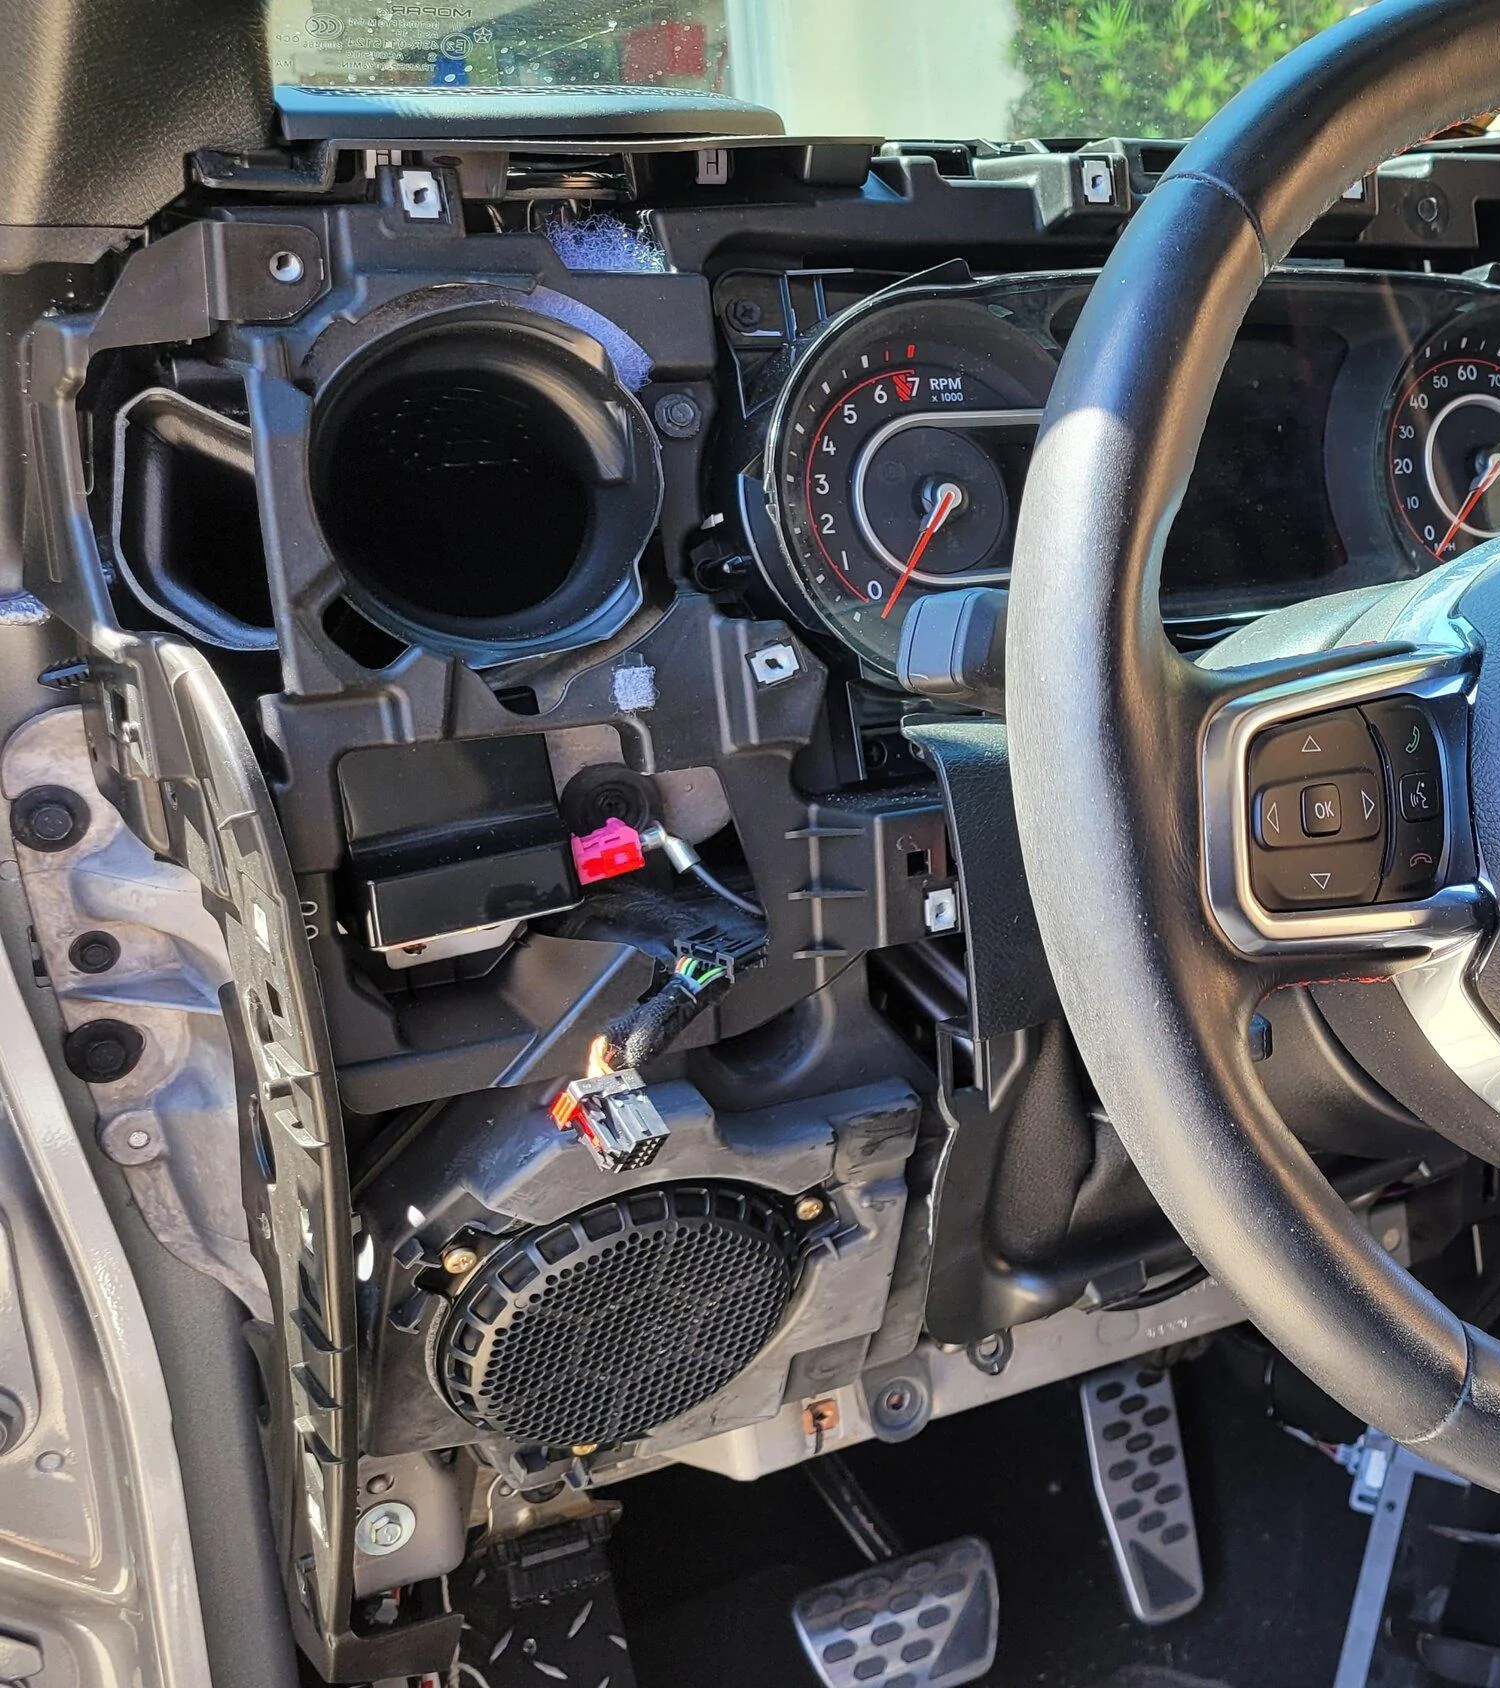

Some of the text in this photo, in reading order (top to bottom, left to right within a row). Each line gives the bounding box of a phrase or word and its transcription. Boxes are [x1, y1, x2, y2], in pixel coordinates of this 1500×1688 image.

[1457, 364, 1478, 381] 60
[906, 377, 920, 397] 7
[929, 377, 962, 391] RPM
[1432, 375, 1449, 389] 50
[873, 384, 888, 404] 6
[941, 392, 964, 402] 1000
[1409, 393, 1429, 409] 40
[843, 403, 858, 424] 5
[1398, 426, 1415, 439] 30
[822, 435, 836, 456] 4
[1393, 458, 1413, 475] 20
[814, 473, 830, 495] 3
[1406, 495, 1420, 510] 10
[820, 513, 836, 534] 2
[1424, 524, 1435, 541] 0
[841, 550, 849, 571] 1
[867, 580, 883, 600] 0
[1314, 800, 1335, 820] OK
